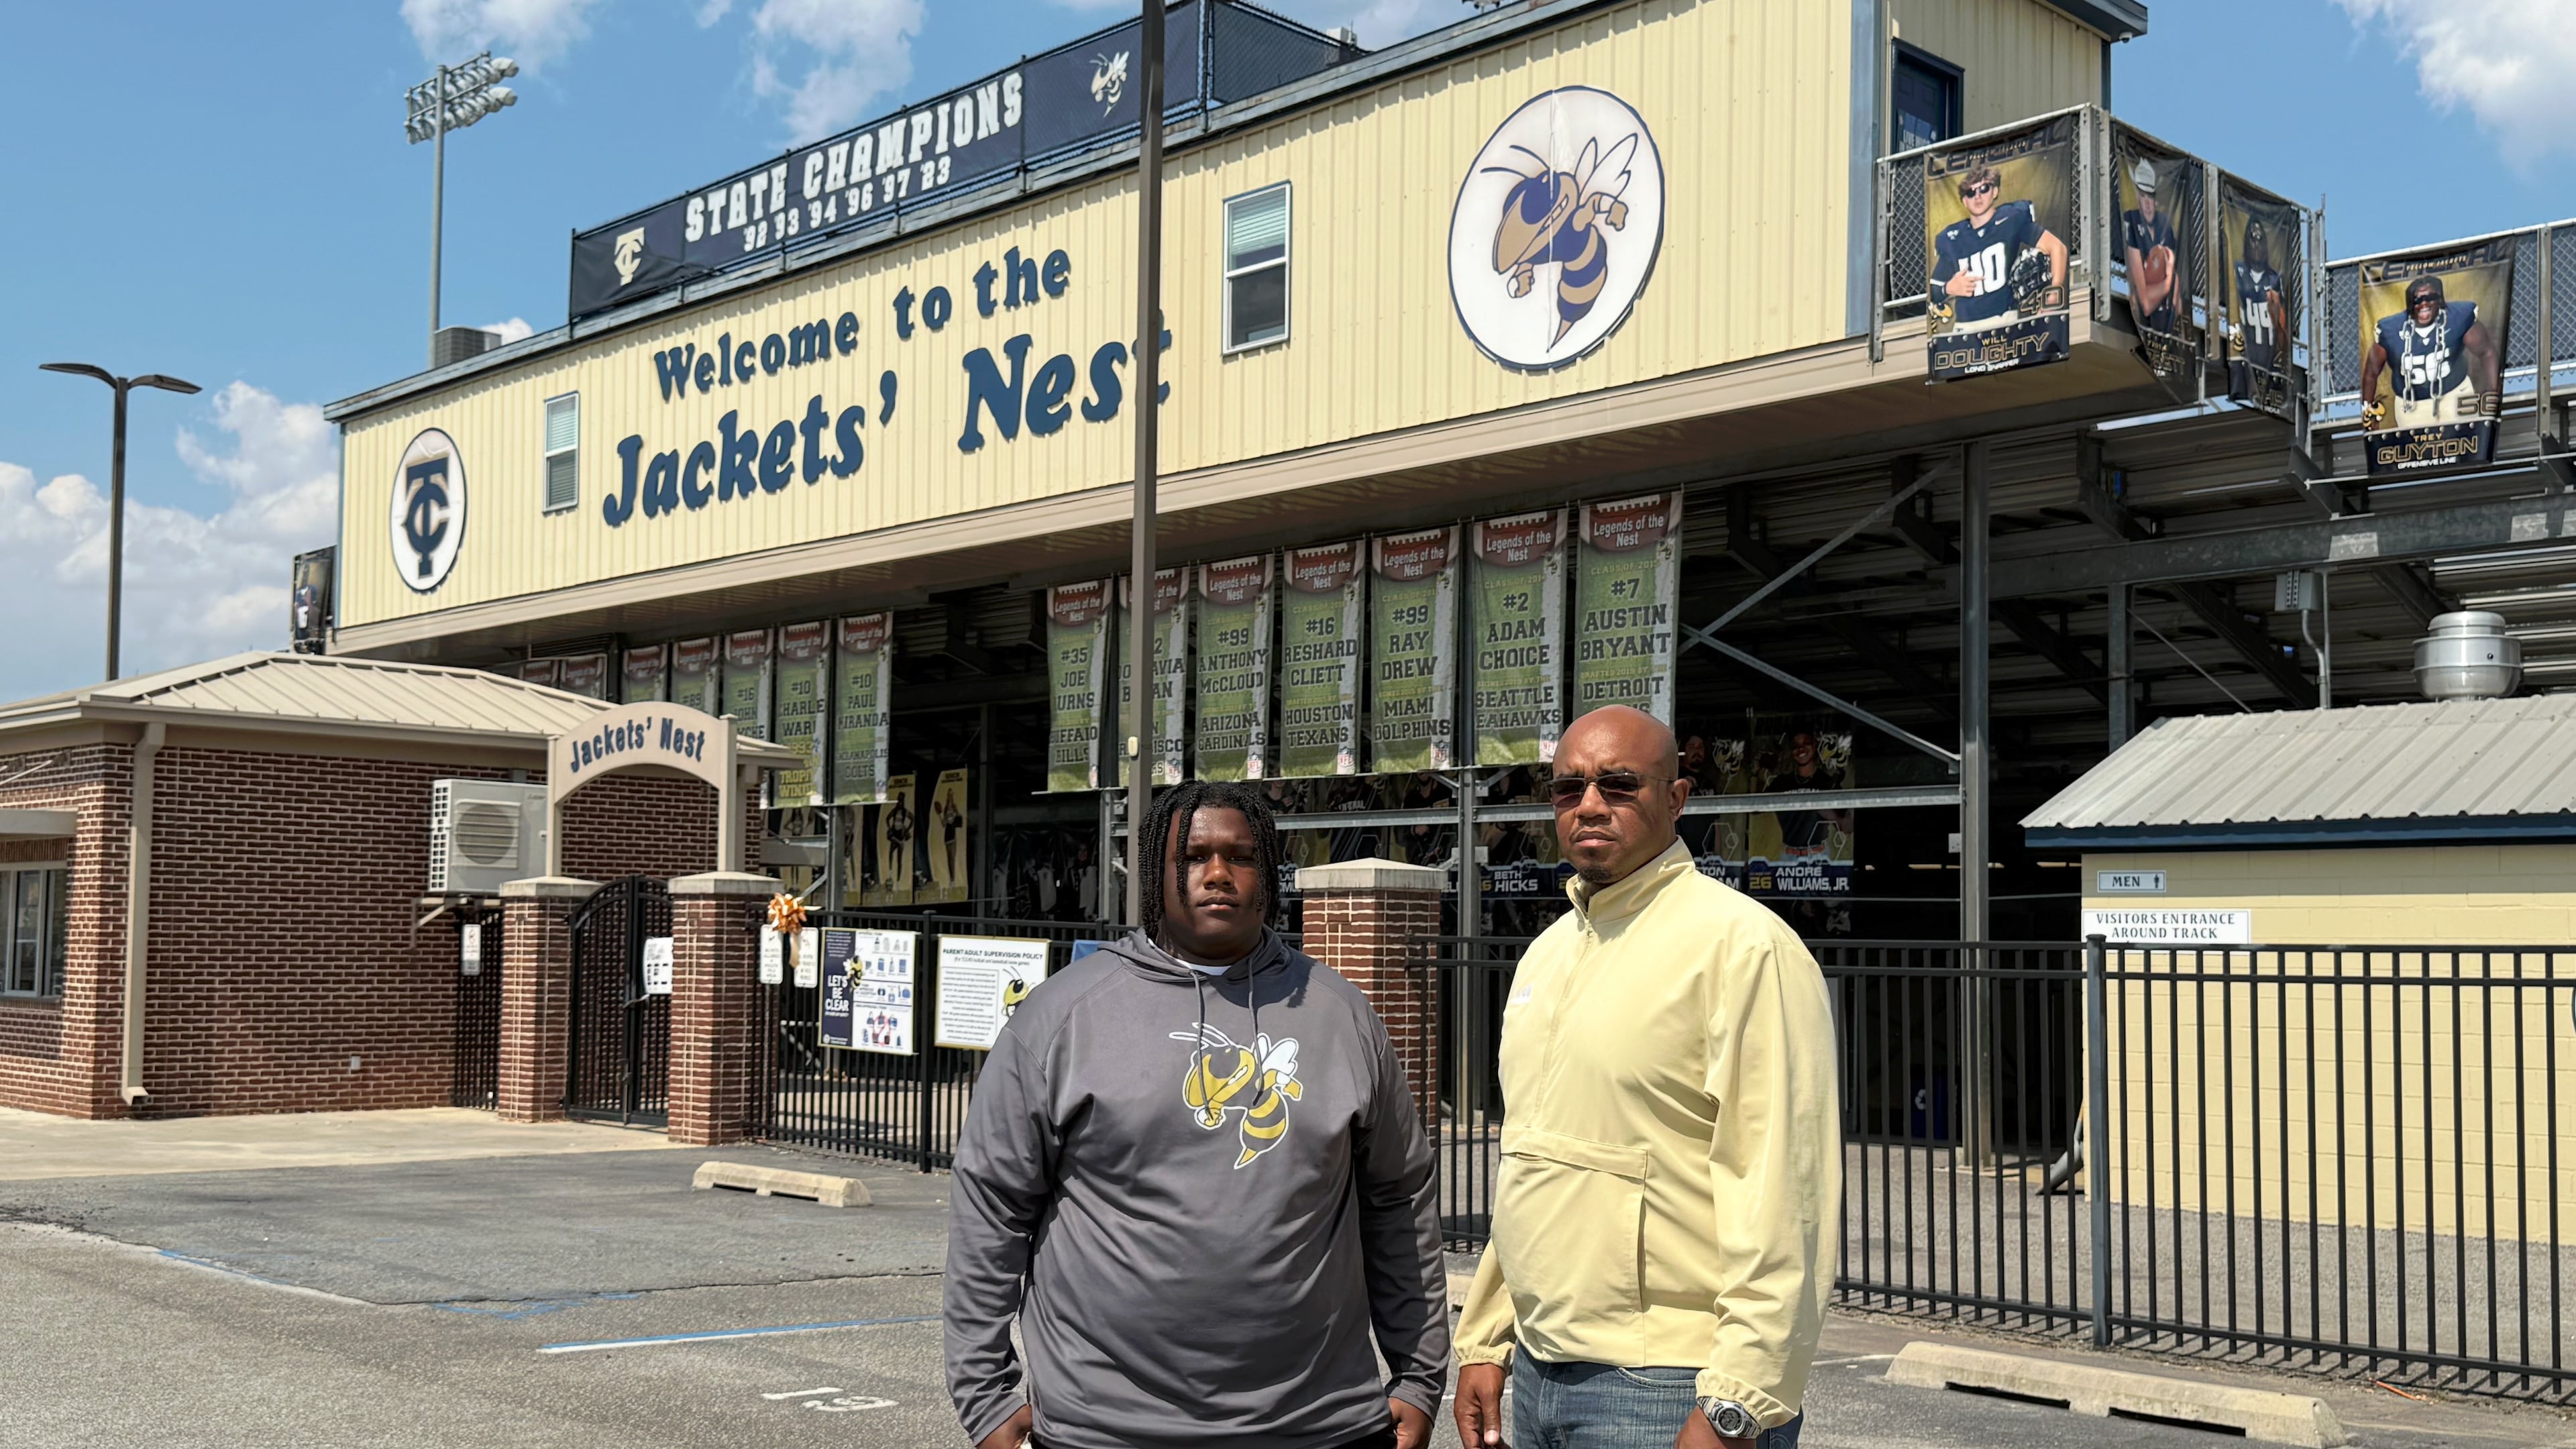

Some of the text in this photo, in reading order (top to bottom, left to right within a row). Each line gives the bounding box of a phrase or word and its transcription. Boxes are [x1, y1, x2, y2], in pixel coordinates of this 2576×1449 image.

[684, 71, 1024, 243] STATE CHAMPIONS
[743, 219, 768, 253] '92
[807, 195, 838, 228] '94
[844, 182, 873, 215] '96
[881, 169, 910, 202] '97
[919, 155, 951, 190] '23
[2020, 286, 2065, 315] 40
[653, 245, 1071, 402] Welcome to the
[1934, 331, 2050, 370] DOUGHTY
[1981, 335, 2008, 346] WILL
[2413, 432, 2443, 442] TREY
[602, 368, 899, 528] Jackets'
[2377, 435, 2478, 466] GUYTON
[2397, 459, 2438, 470] OFFENSIVE
[1593, 515, 1664, 537] Legends of the
[1486, 531, 1551, 553] Legends of the
[1616, 534, 1639, 548] Nest
[1384, 547, 1445, 568] Legends of the
[1507, 547, 1528, 562] Nest
[1295, 561, 1351, 582] Legends of the
[1403, 563, 1424, 578] Nest
[1210, 574, 1262, 592] Legends of the
[1313, 576, 1332, 590] Nest
[1611, 578, 1640, 599] #7
[1227, 589, 1244, 600] Nest
[1503, 592, 1529, 612] #2
[1391, 605, 1429, 625] #99
[1583, 603, 1668, 633] AUSTIN
[1218, 627, 1250, 646] #99
[1305, 616, 1335, 636] #16
[1486, 617, 1546, 644] ADAM
[1285, 639, 1358, 665] RESHARD
[1389, 631, 1430, 653] RAY
[1579, 632, 1672, 662] BRYANT
[1061, 647, 1089, 665] #35
[1198, 648, 1270, 673] ANTHONY
[1479, 645, 1550, 671] CHOICE
[1291, 664, 1346, 687] CLIETT
[1381, 655, 1438, 682] DREW
[790, 680, 812, 695] #10
[852, 674, 873, 689] #10
[1060, 671, 1085, 689] JOE
[1199, 672, 1264, 695] McCLOUD
[1582, 676, 1664, 702] DETROIT
[737, 687, 755, 701] #16
[847, 694, 875, 709] PAUL
[1475, 686, 1554, 708] SEATTLE
[1285, 704, 1354, 726] HOUSTON
[1383, 696, 1434, 718] MIAMI
[1201, 711, 1262, 733] ARIZONA
[1476, 708, 1562, 730] EAHAWKS
[1287, 726, 1349, 749] TEXANS
[1374, 718, 1451, 742] DOLPHINS
[570, 715, 706, 774] Jackets' Nest
[1494, 870, 1522, 880] BETH
[1775, 866, 1823, 877] ANDRE
[2112, 875, 2141, 888] MEN
[1494, 879, 1538, 892] HICKS
[1749, 877, 1772, 890] 26
[1777, 877, 1832, 892] WILLIAMS,
[2096, 913, 2235, 924] VISITORS ENTRANCE
[2112, 927, 2218, 938] AROUND TRACK
[832, 987, 843, 999] BE
[824, 998, 849, 1012] CLEAR
